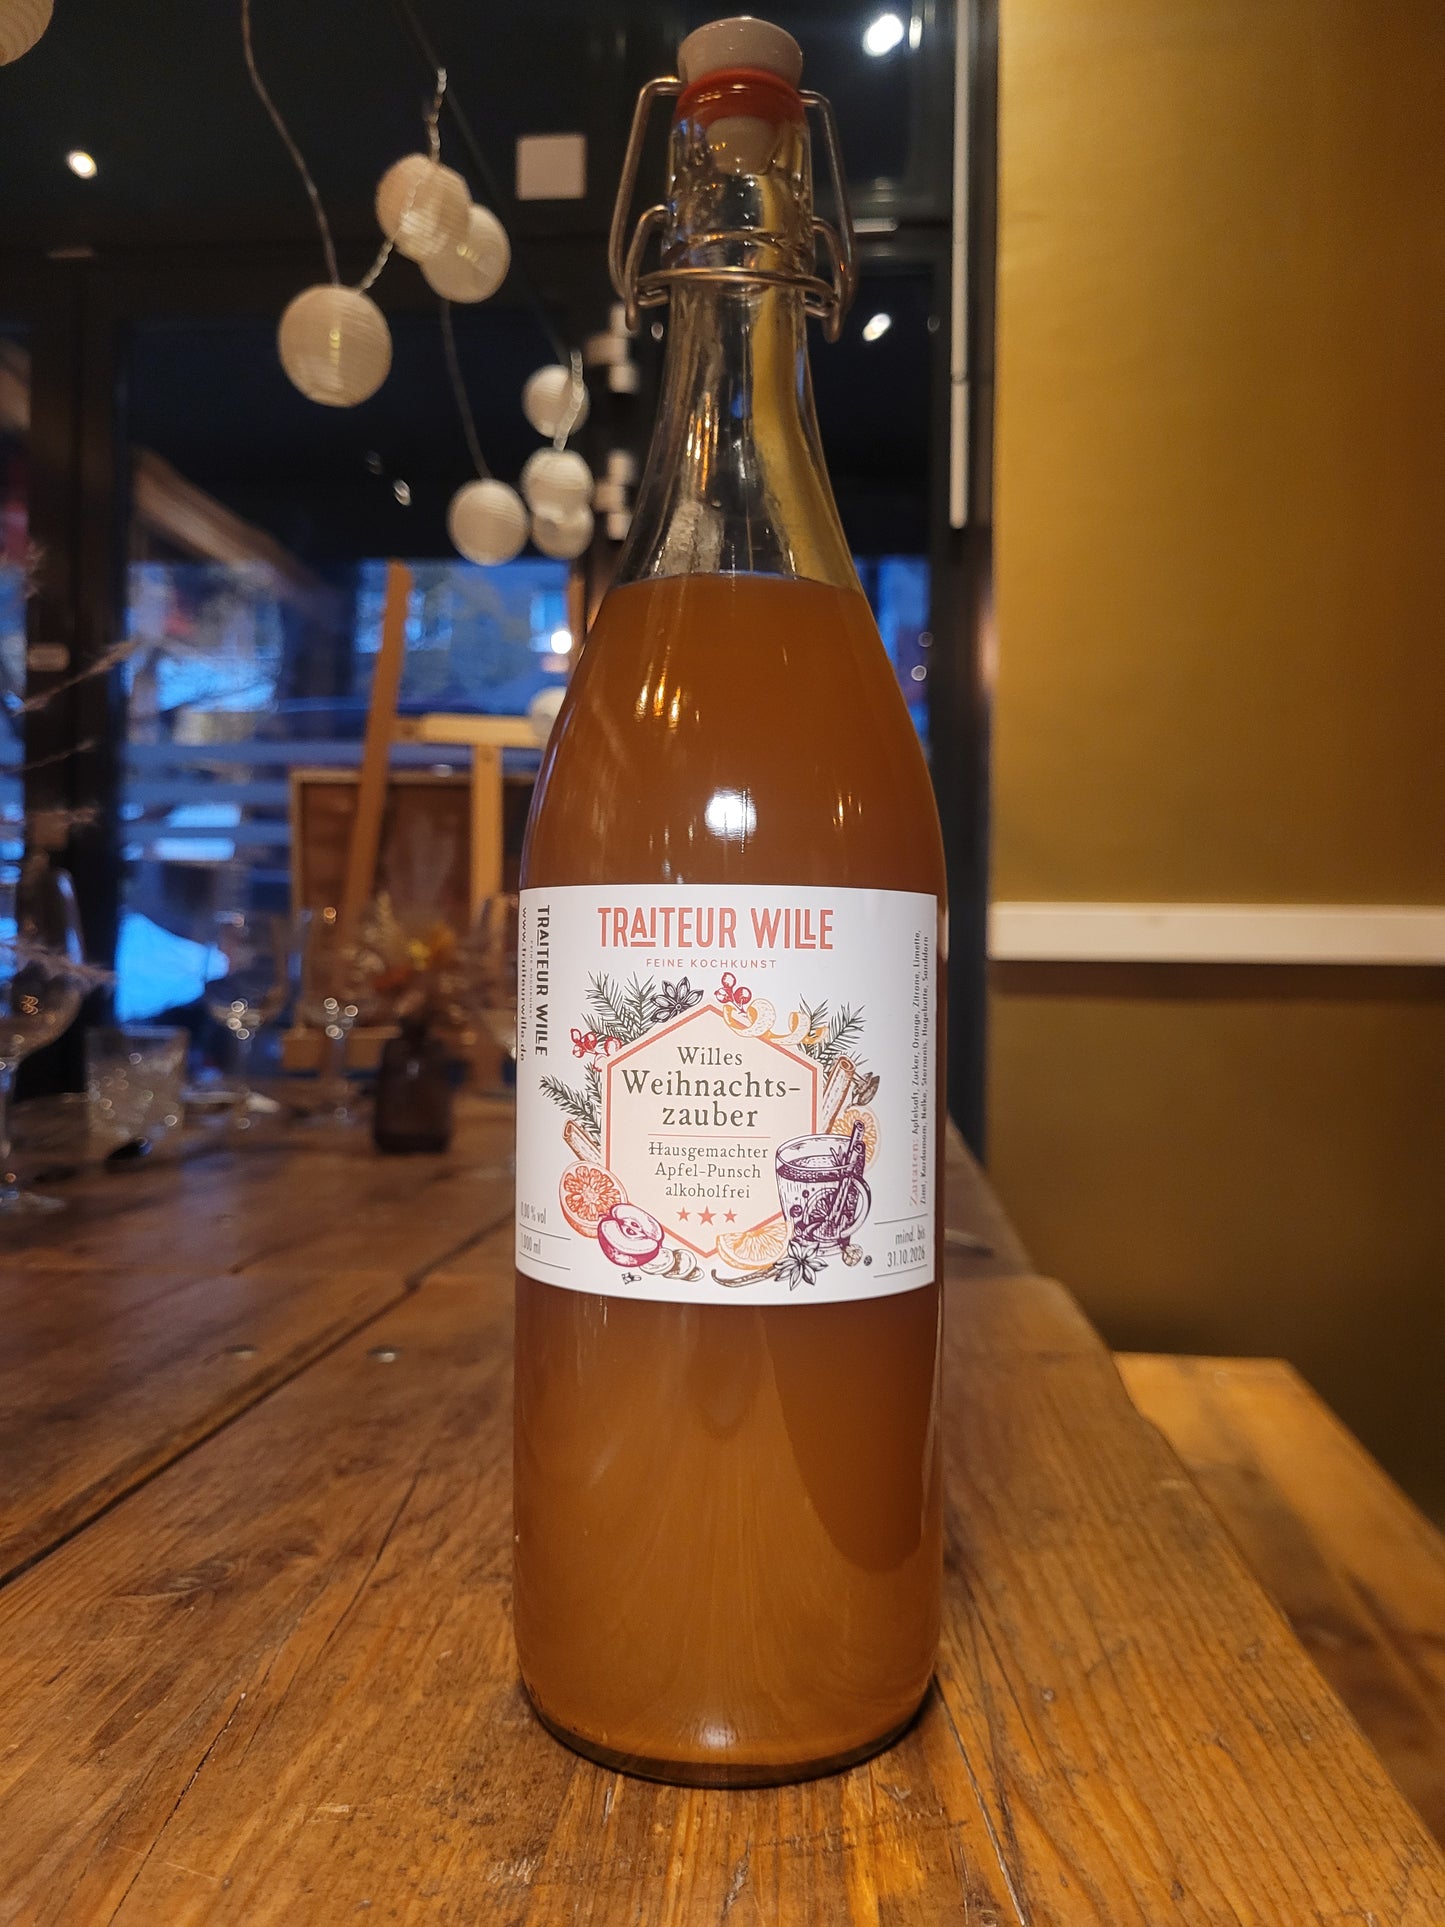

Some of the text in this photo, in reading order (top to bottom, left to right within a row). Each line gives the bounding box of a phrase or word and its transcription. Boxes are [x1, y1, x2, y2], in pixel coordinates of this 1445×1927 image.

[597, 907, 833, 949] TRAITEUR WILLE
[647, 959, 776, 968] FEINE KOCHKUNST
[912, 930, 922, 967] Limette,
[535, 905, 550, 1057] TRAITEUR WILLE
[912, 971, 921, 1007] Zitrone,
[911, 1011, 921, 1049] Orange,
[677, 1047, 742, 1065] Willes
[911, 1052, 920, 1086] Zucker,
[622, 1070, 800, 1097] Weihnachts-
[663, 1100, 758, 1127] zauber
[910, 1089, 920, 1135] Apfelsaft,
[648, 1142, 768, 1161] Hausgemachter
[655, 1162, 760, 1180] Apfel-Punsch
[666, 1183, 749, 1198] alkoholfrei
